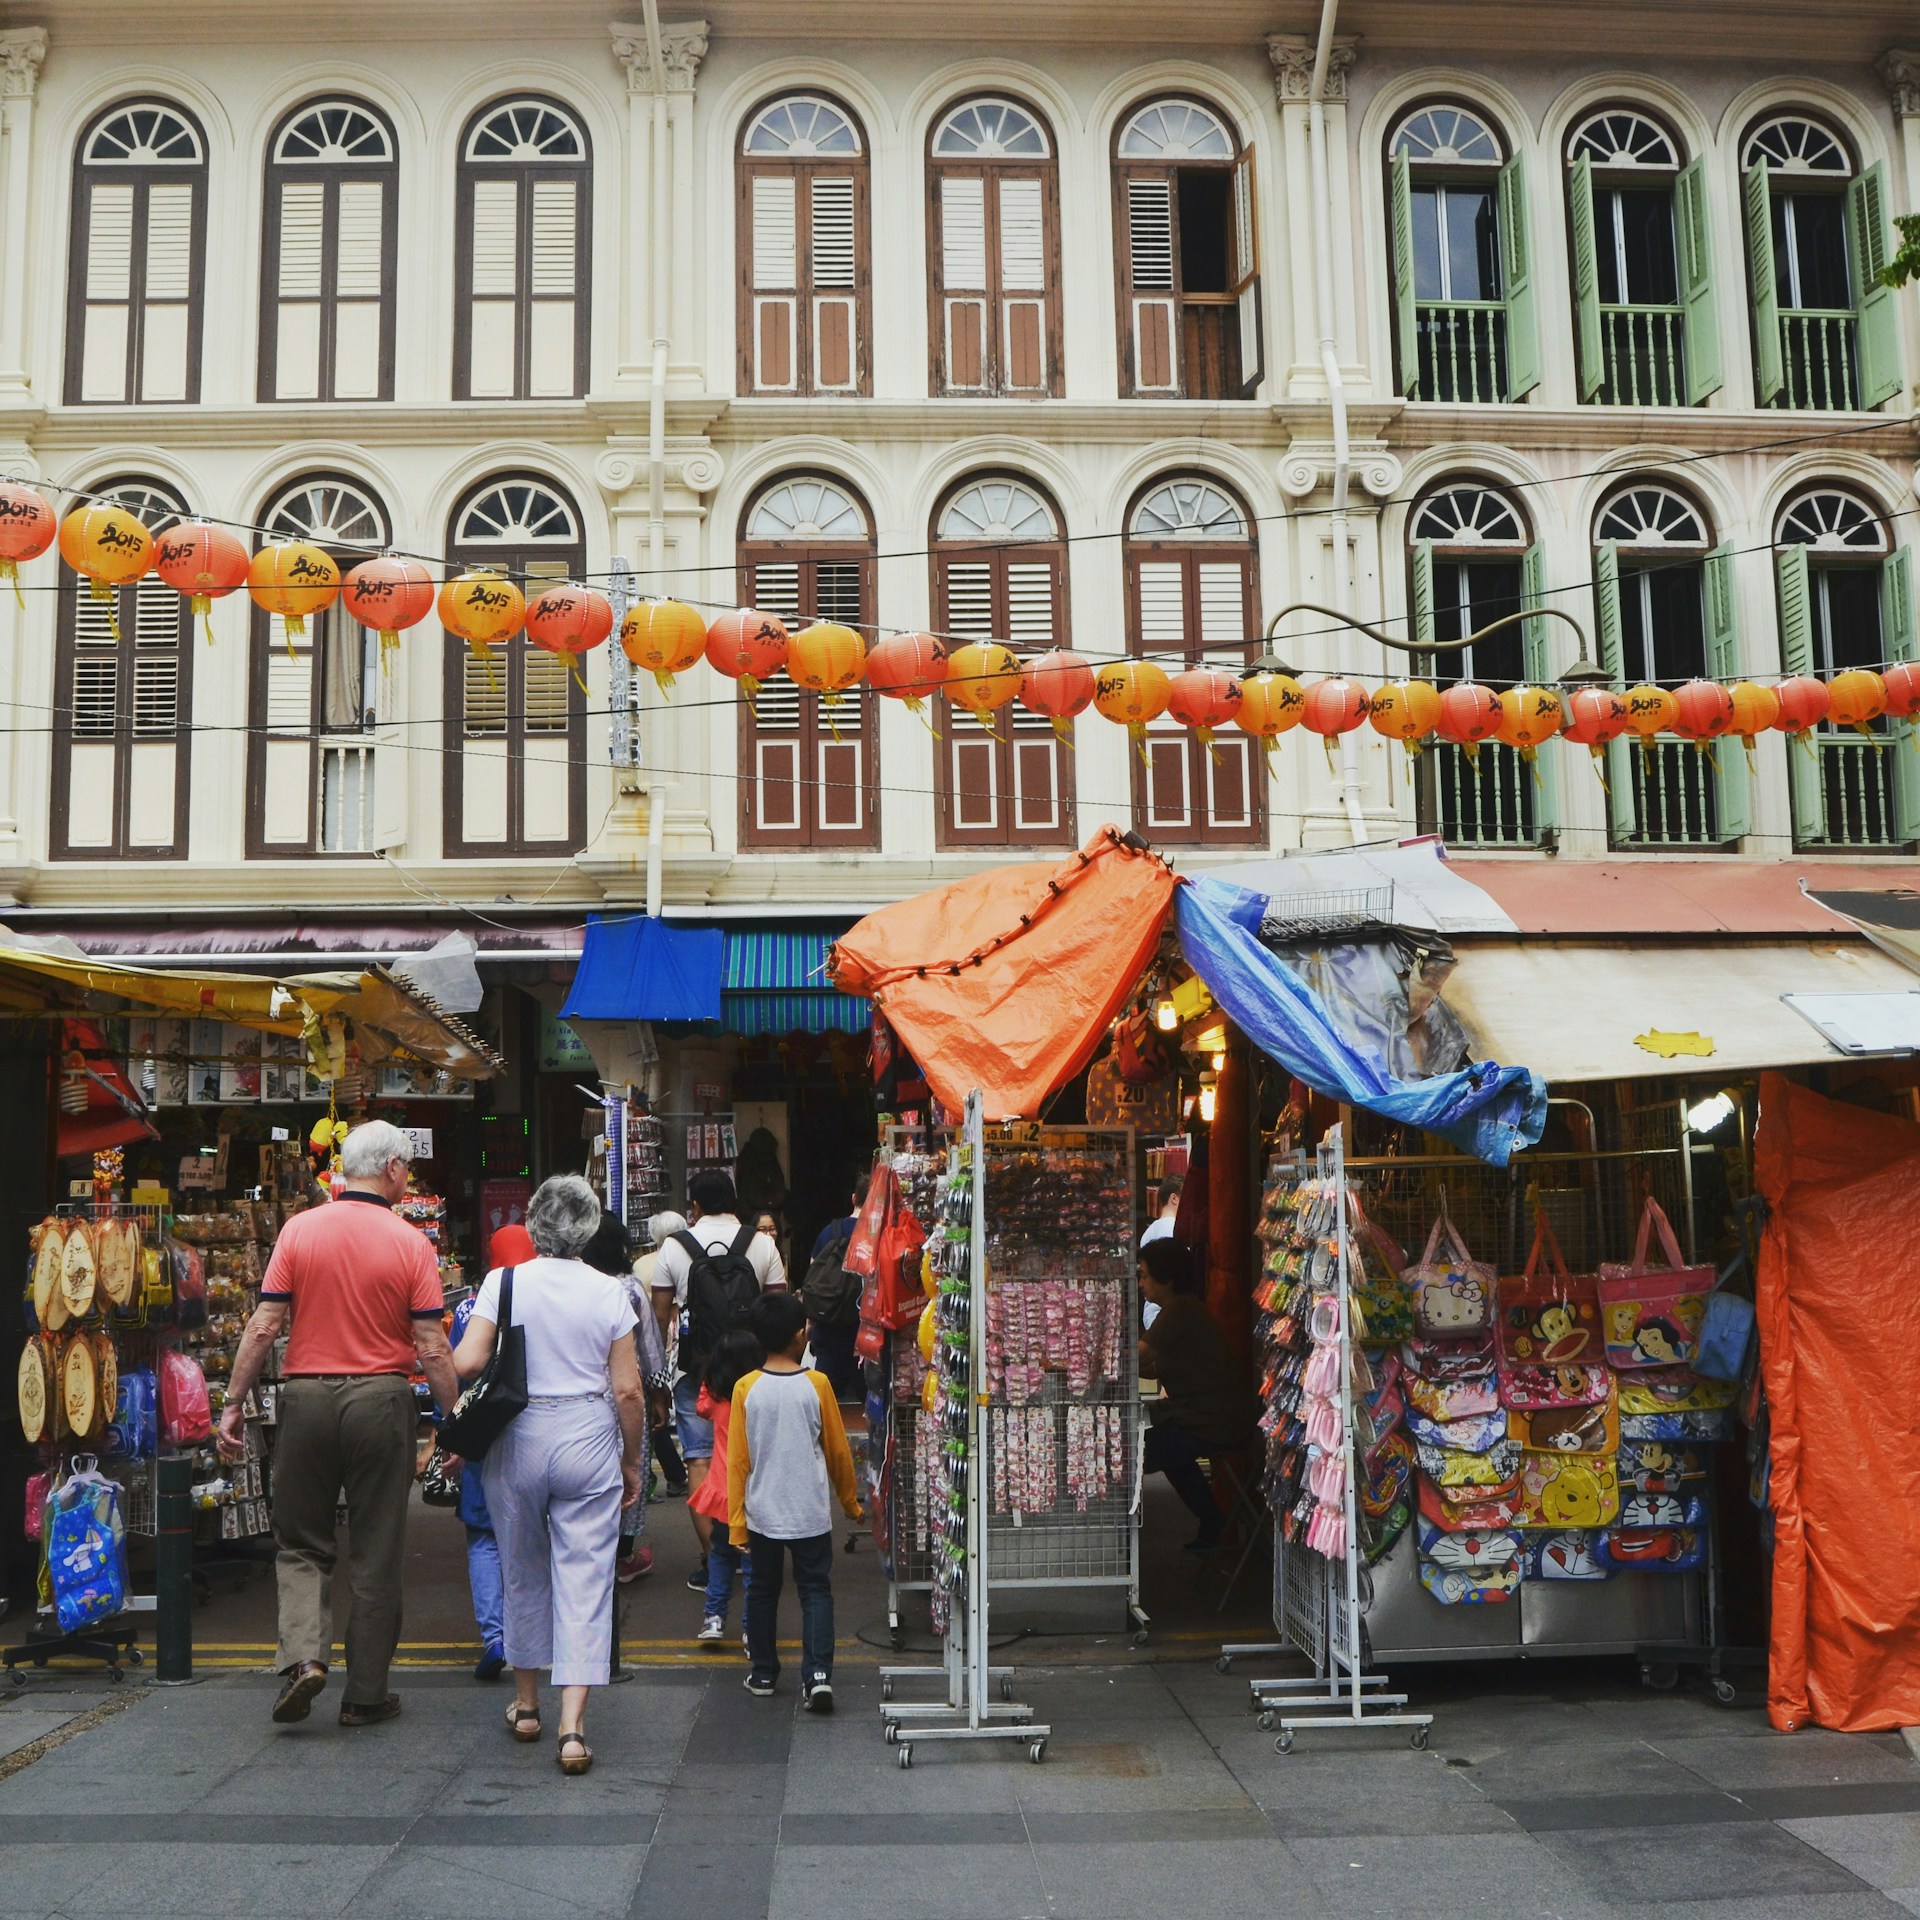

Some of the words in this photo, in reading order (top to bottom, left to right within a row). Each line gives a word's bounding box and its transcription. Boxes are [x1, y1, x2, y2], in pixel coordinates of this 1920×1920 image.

[97, 521, 143, 552] 2015
[158, 541, 195, 566] 2015
[289, 554, 331, 581] 2015
[355, 575, 396, 601] 2015
[466, 584, 509, 608] 2015
[535, 598, 576, 620] 2015
[1630, 696, 1662, 715] 2015
[1117, 1087, 1144, 1103] $20
[1023, 1123, 1040, 1142] $2
